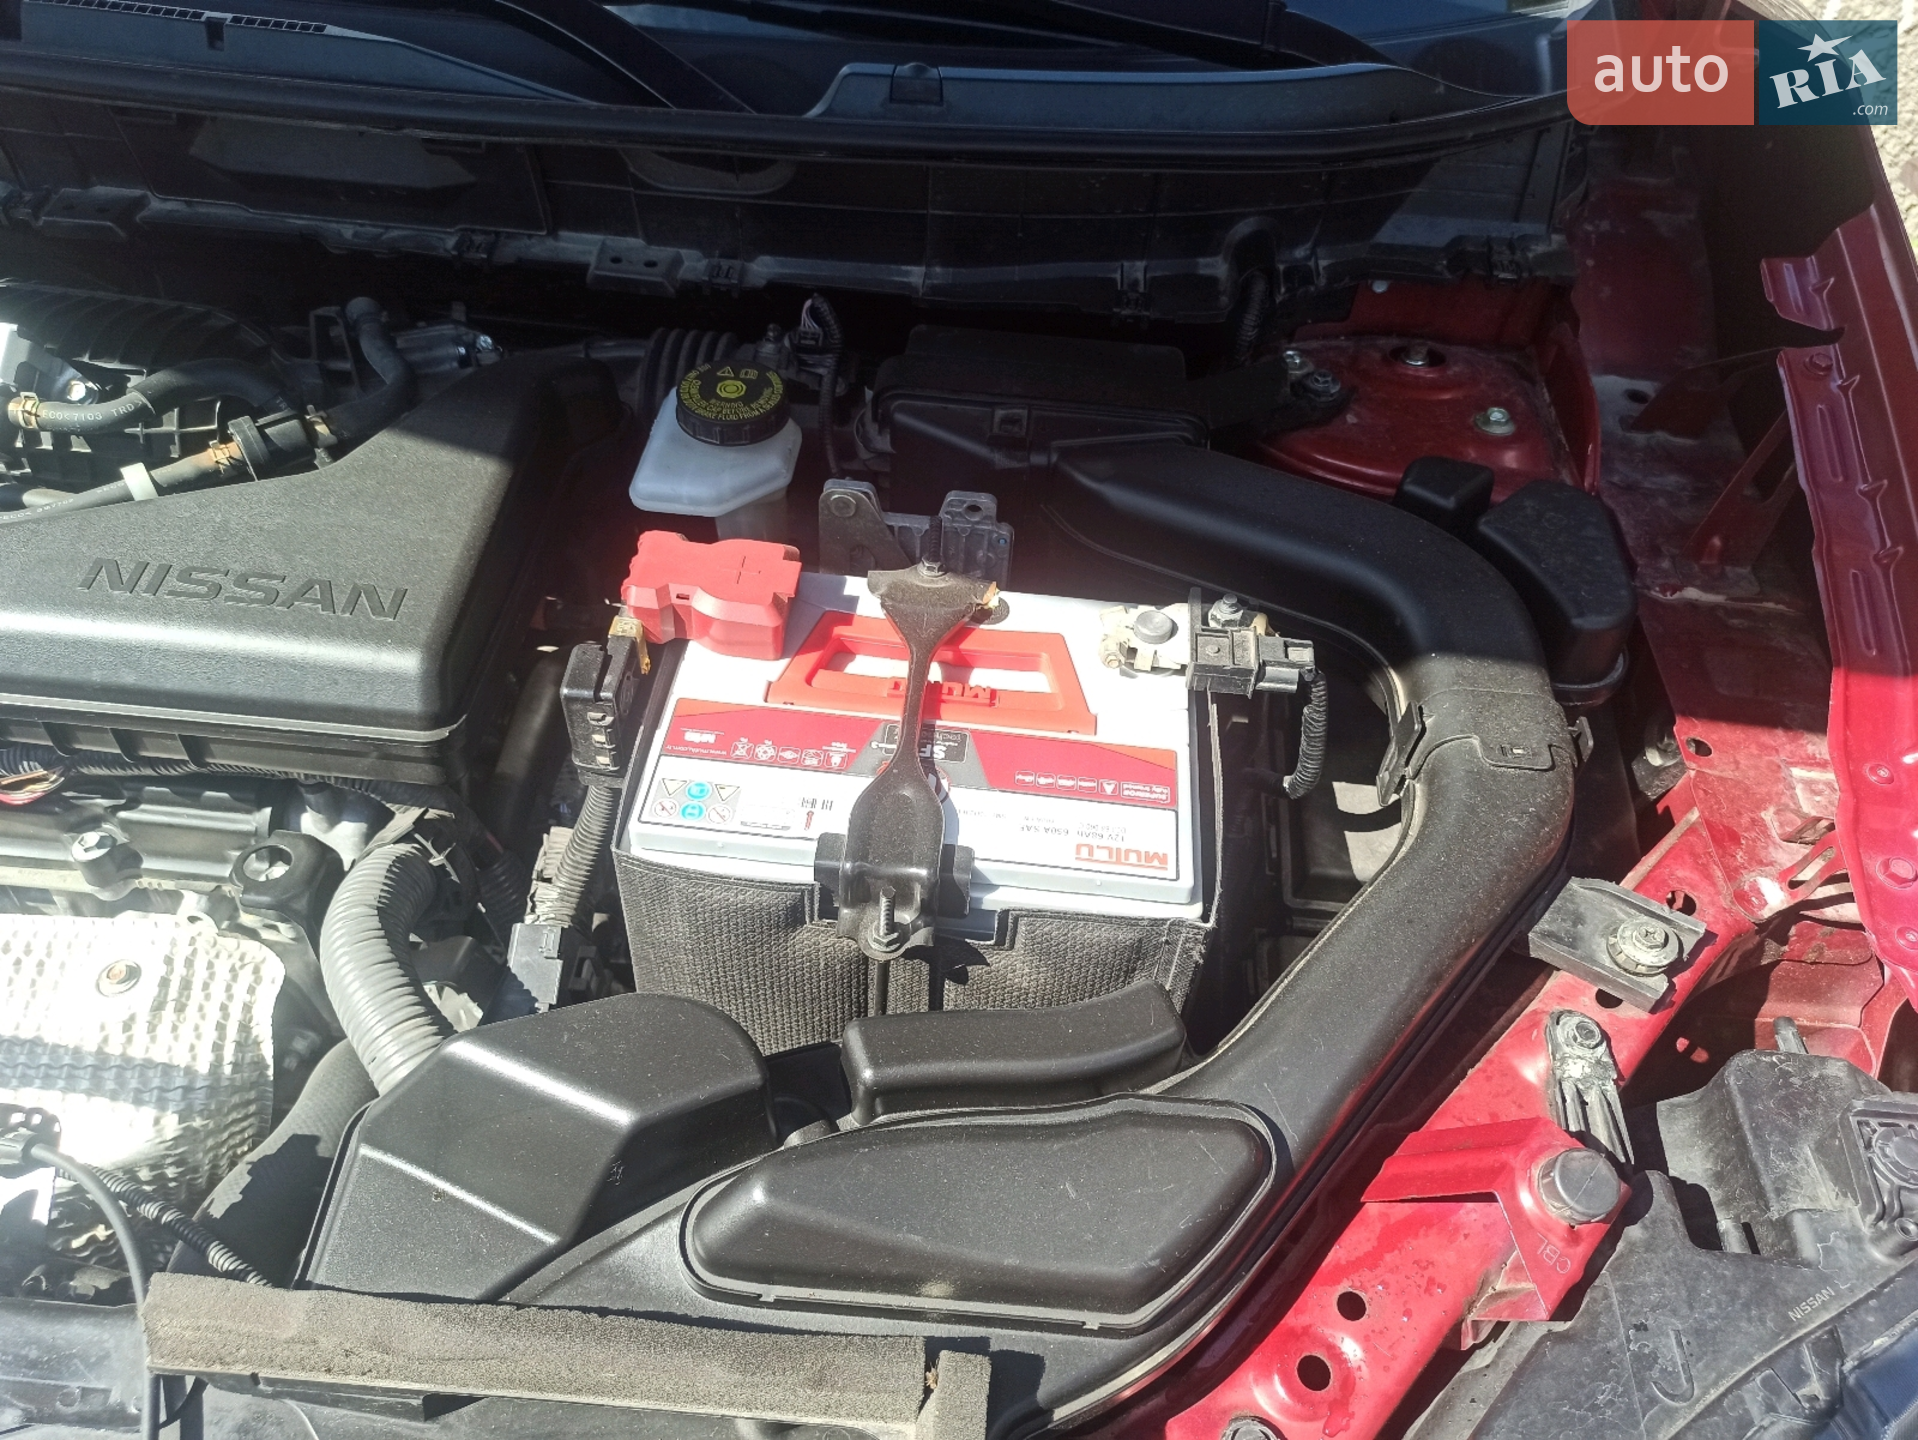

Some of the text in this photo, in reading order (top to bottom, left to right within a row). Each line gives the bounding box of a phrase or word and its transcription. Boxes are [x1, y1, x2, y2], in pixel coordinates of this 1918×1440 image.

[77, 557, 408, 621] NISSAN
[1075, 843, 1168, 871] MUTLU
[1787, 1285, 1835, 1323] NISSAN
